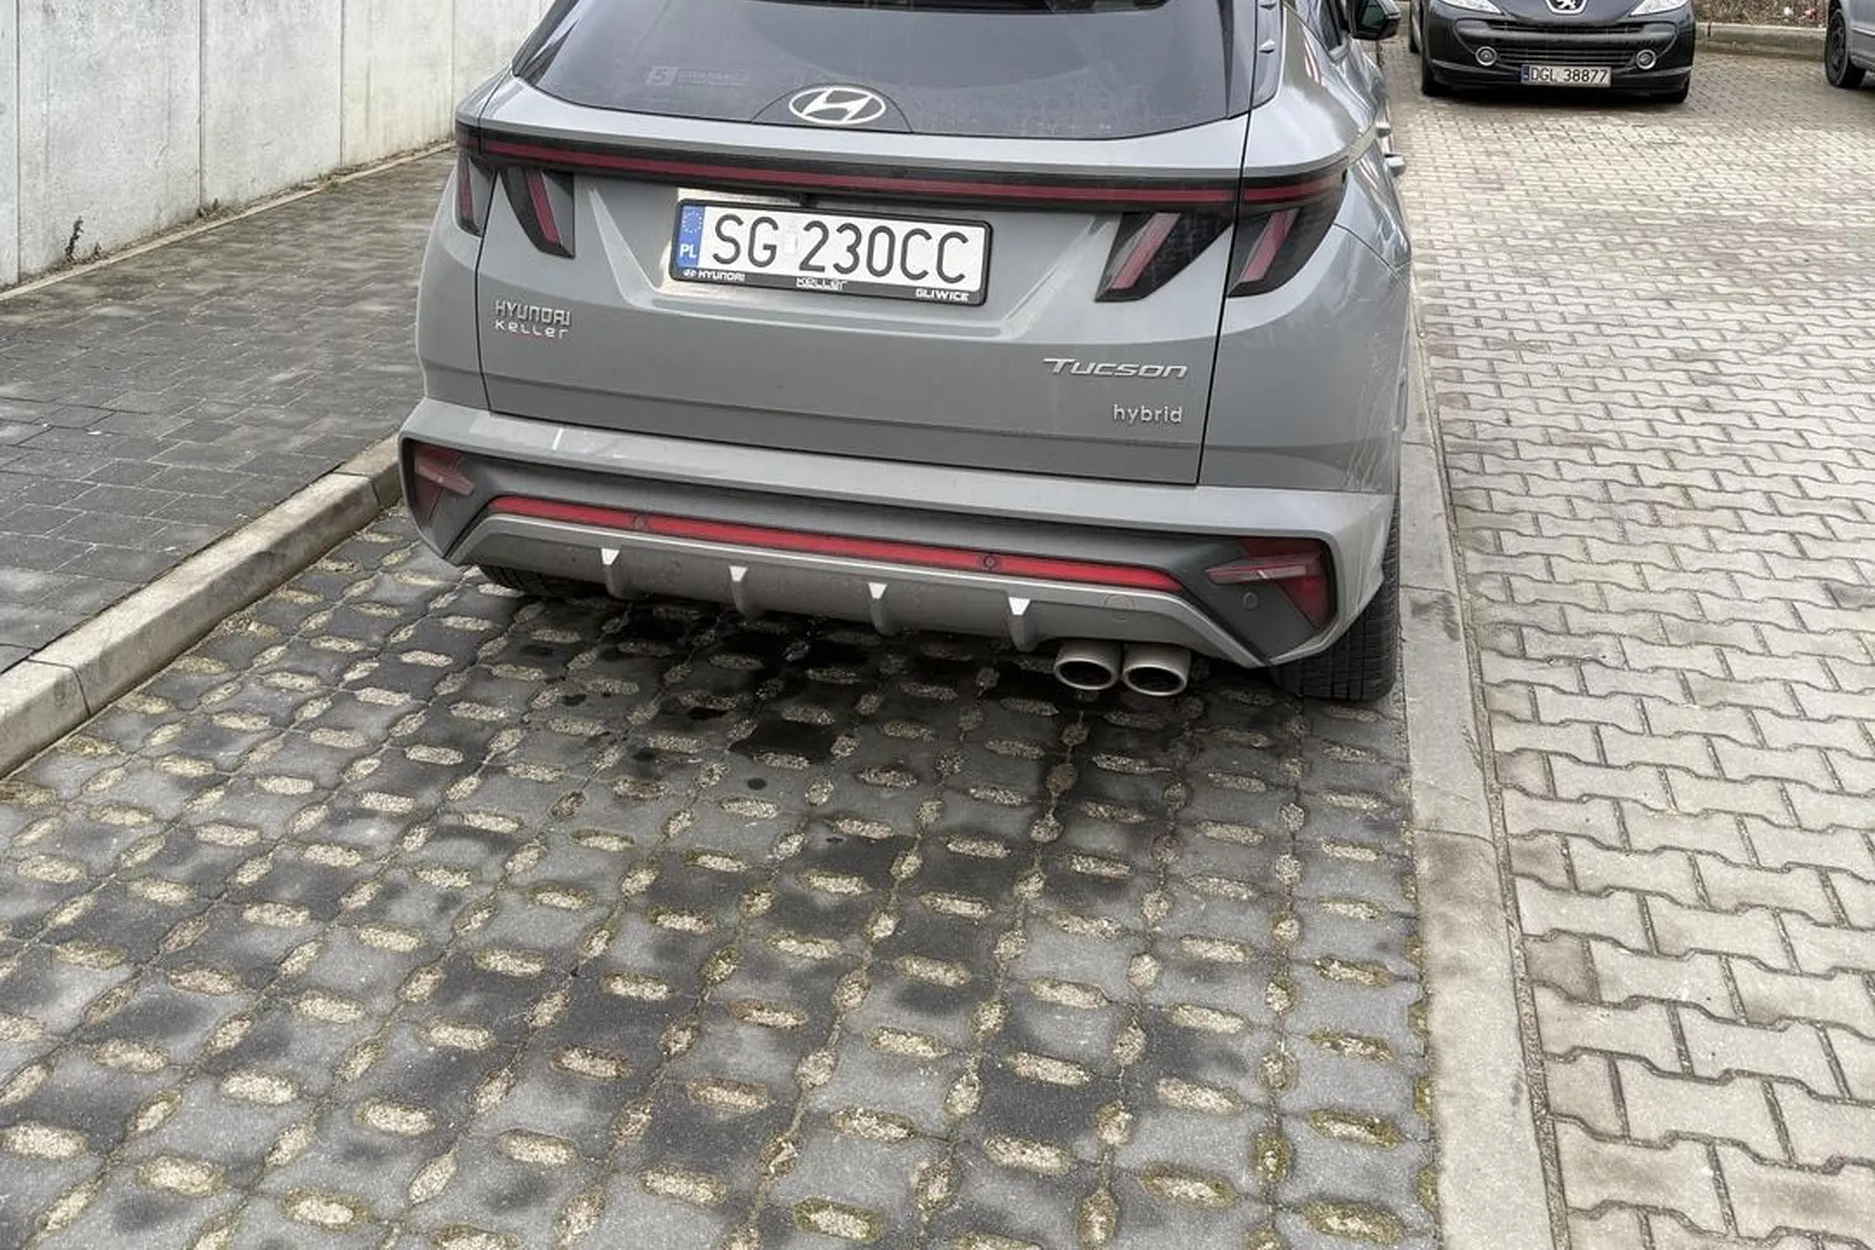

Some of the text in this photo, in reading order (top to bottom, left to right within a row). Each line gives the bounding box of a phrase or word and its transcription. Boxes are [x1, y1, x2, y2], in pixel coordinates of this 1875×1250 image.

[1531, 67, 1556, 81] DGL
[1563, 68, 1608, 82] 38877
[680, 244, 697, 258] PL
[712, 213, 969, 284] SG 230CC
[698, 269, 746, 282] HYUNDAI
[494, 299, 571, 326] HYUNDAI
[1112, 403, 1184, 424] hybrid
